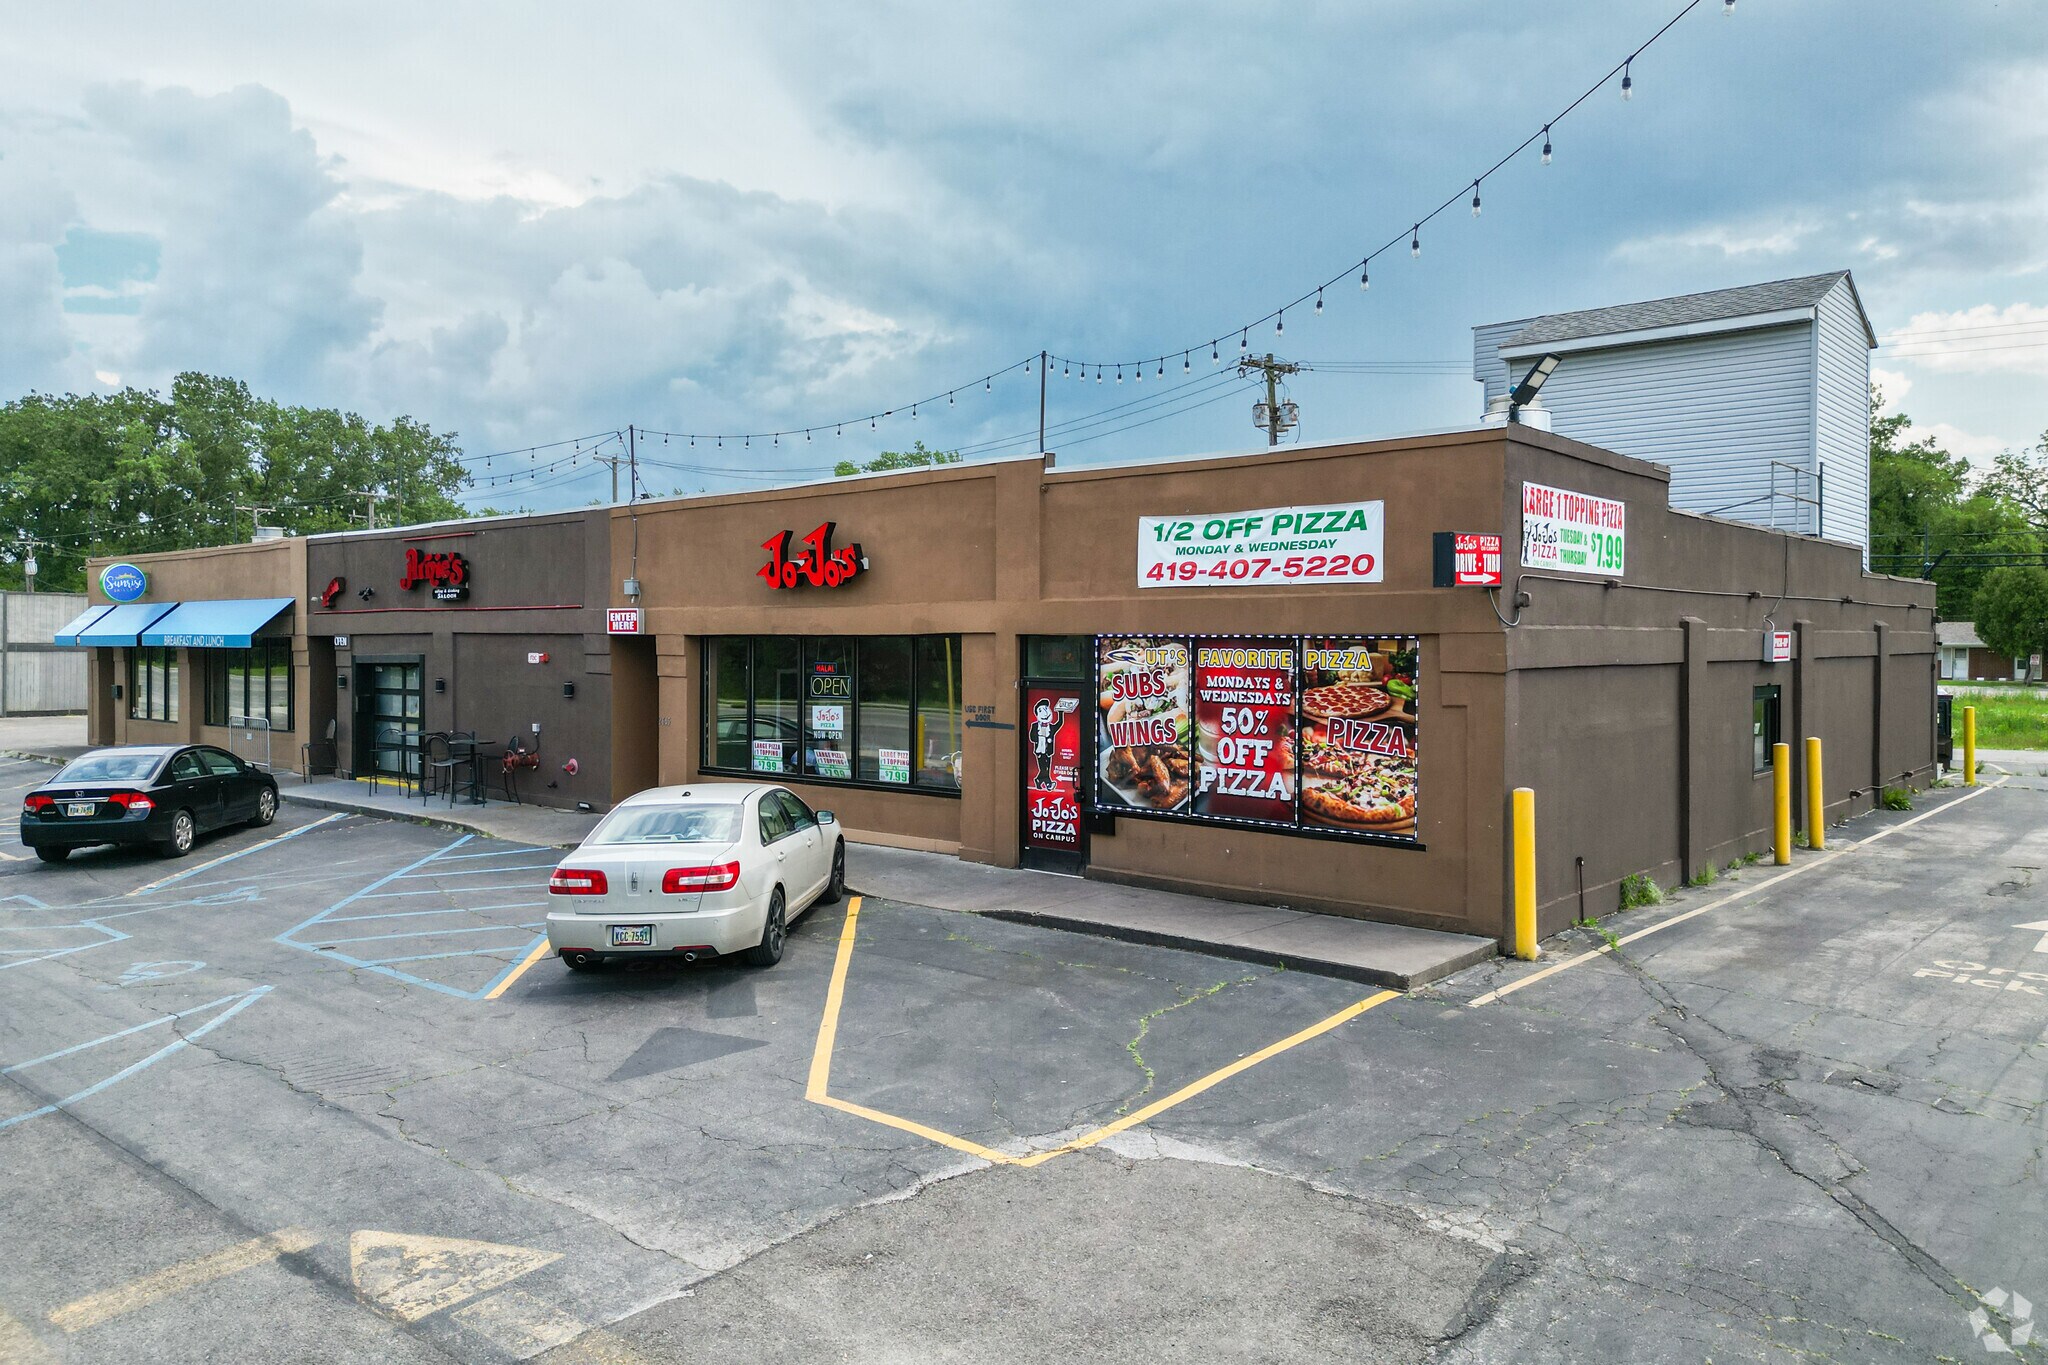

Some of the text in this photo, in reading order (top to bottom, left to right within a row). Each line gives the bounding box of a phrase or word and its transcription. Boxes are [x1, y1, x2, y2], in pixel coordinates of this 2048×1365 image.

[1524, 486, 1623, 530] LARGE 1 TOPPING PIZZA
[1154, 509, 1368, 542] 1/2 OFF PIZZA
[1480, 536, 1500, 547] PIZZA
[1560, 528, 1588, 546] TUESDAY &
[1175, 539, 1338, 556] MONDAY & WEDNESDAY
[1532, 544, 1558, 560] PIZZA
[1591, 531, 1623, 570] $7.99
[1455, 553, 1477, 573] DRIVE
[1483, 553, 1501, 573] THRU
[1560, 548, 1588, 566] THURSDAY
[1146, 553, 1375, 581] 419-407-5220
[106, 575, 144, 589] Sunrise
[610, 612, 636, 621] ENTER
[612, 621, 635, 630] HERE
[164, 635, 224, 647] BREAKFAST AND LUNCH
[334, 636, 347, 646] OPEN
[816, 664, 835, 672] HALAL
[1145, 648, 1372, 671] UT'S FAVORITE PIZZA
[812, 678, 850, 695] OPEN
[1112, 669, 1166, 701] SUBS
[1206, 675, 1284, 690] MONDAYS &
[1200, 689, 1292, 706] WEDNESDAYS
[1221, 707, 1269, 735] 50%
[813, 730, 843, 740] NOW OPEN
[1109, 717, 1178, 748] WINGS
[1327, 717, 1407, 757] PIZZA
[1217, 736, 1273, 767] OFF
[758, 760, 777, 771] $7.99
[824, 768, 846, 779] $799
[885, 770, 907, 782] $7.99
[1199, 765, 1292, 801] PIZZA
[1032, 819, 1076, 836] PIZZA
[1045, 833, 1075, 843] CAMPUS
[631, 930, 649, 942] 7551
